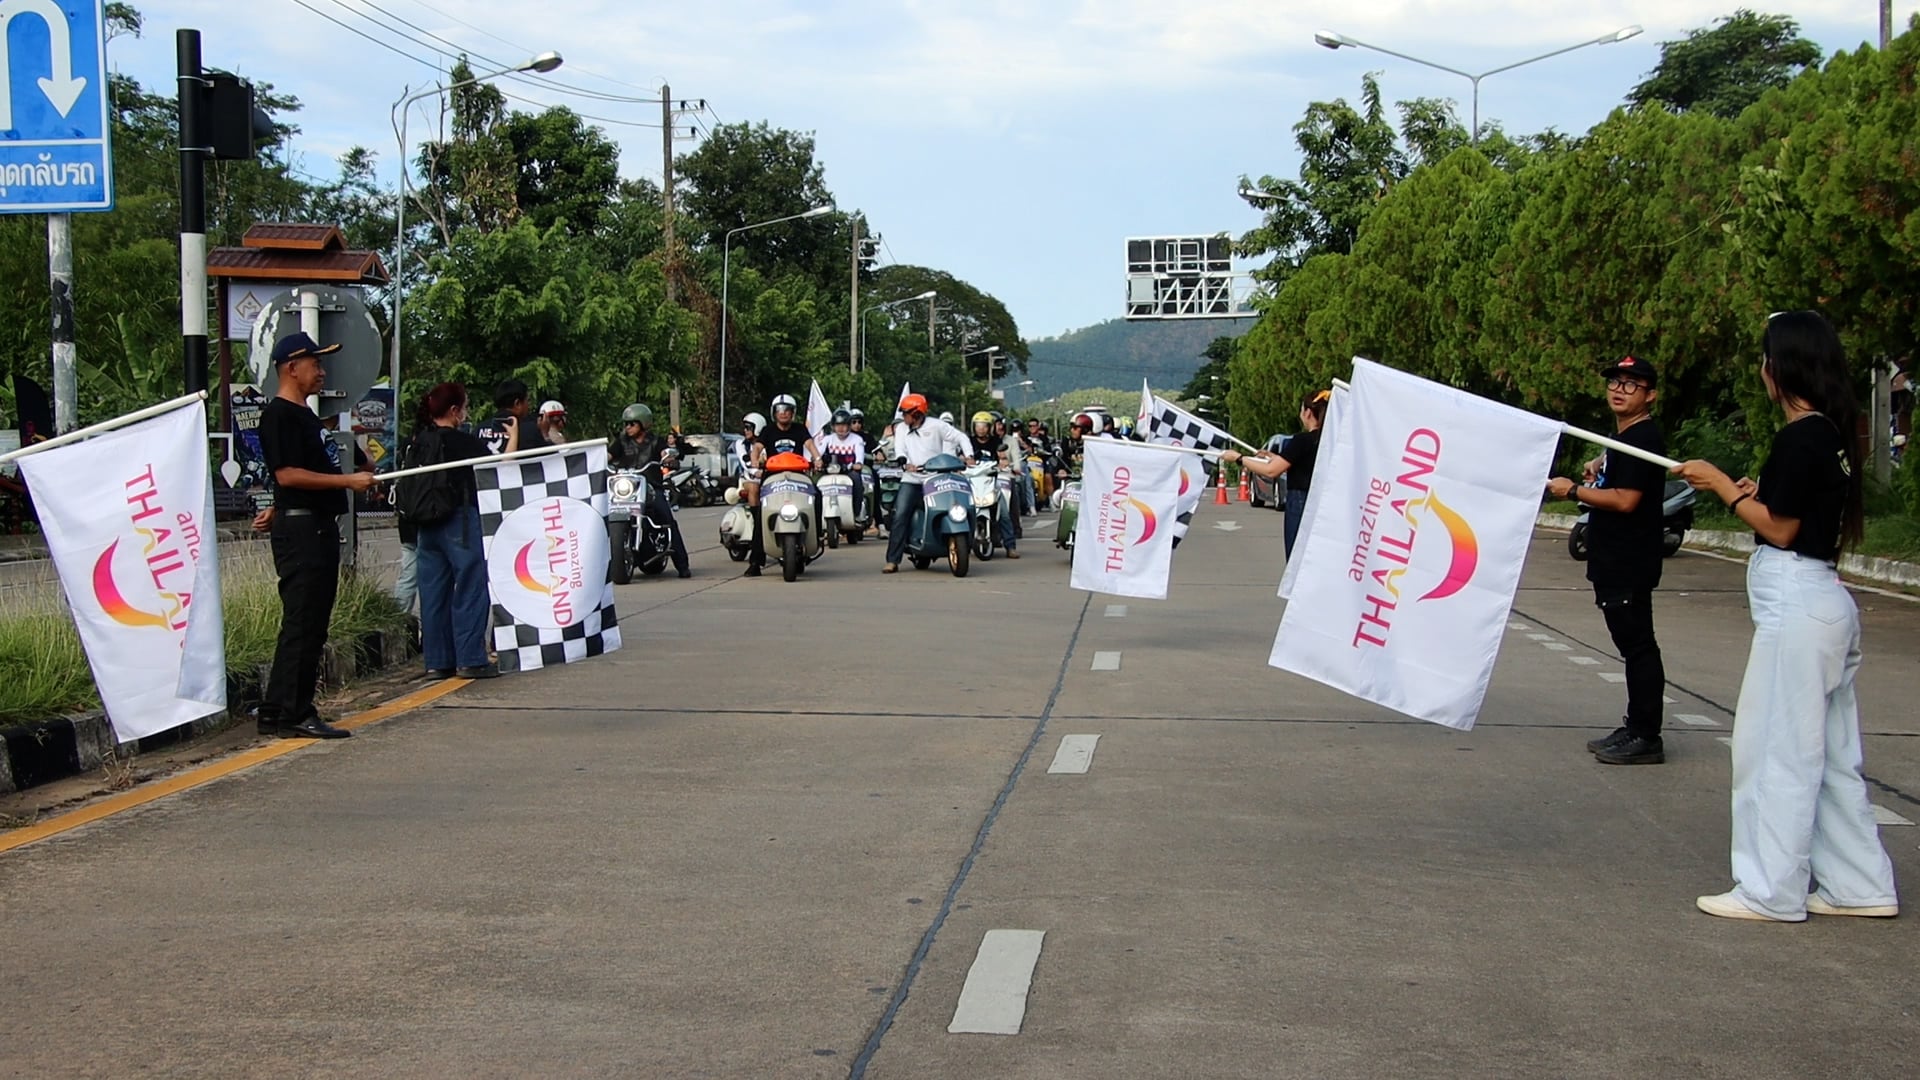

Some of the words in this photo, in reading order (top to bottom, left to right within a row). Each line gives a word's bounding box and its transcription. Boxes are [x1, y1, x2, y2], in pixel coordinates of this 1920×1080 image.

[125, 463, 193, 649] THAILA
[542, 499, 573, 626] THAILAND
[569, 530, 583, 589] amazing
[1097, 492, 1112, 544] amazing
[1105, 466, 1131, 573] THAILAND
[1348, 477, 1391, 582] amazing
[1352, 428, 1441, 648] THAILAND
